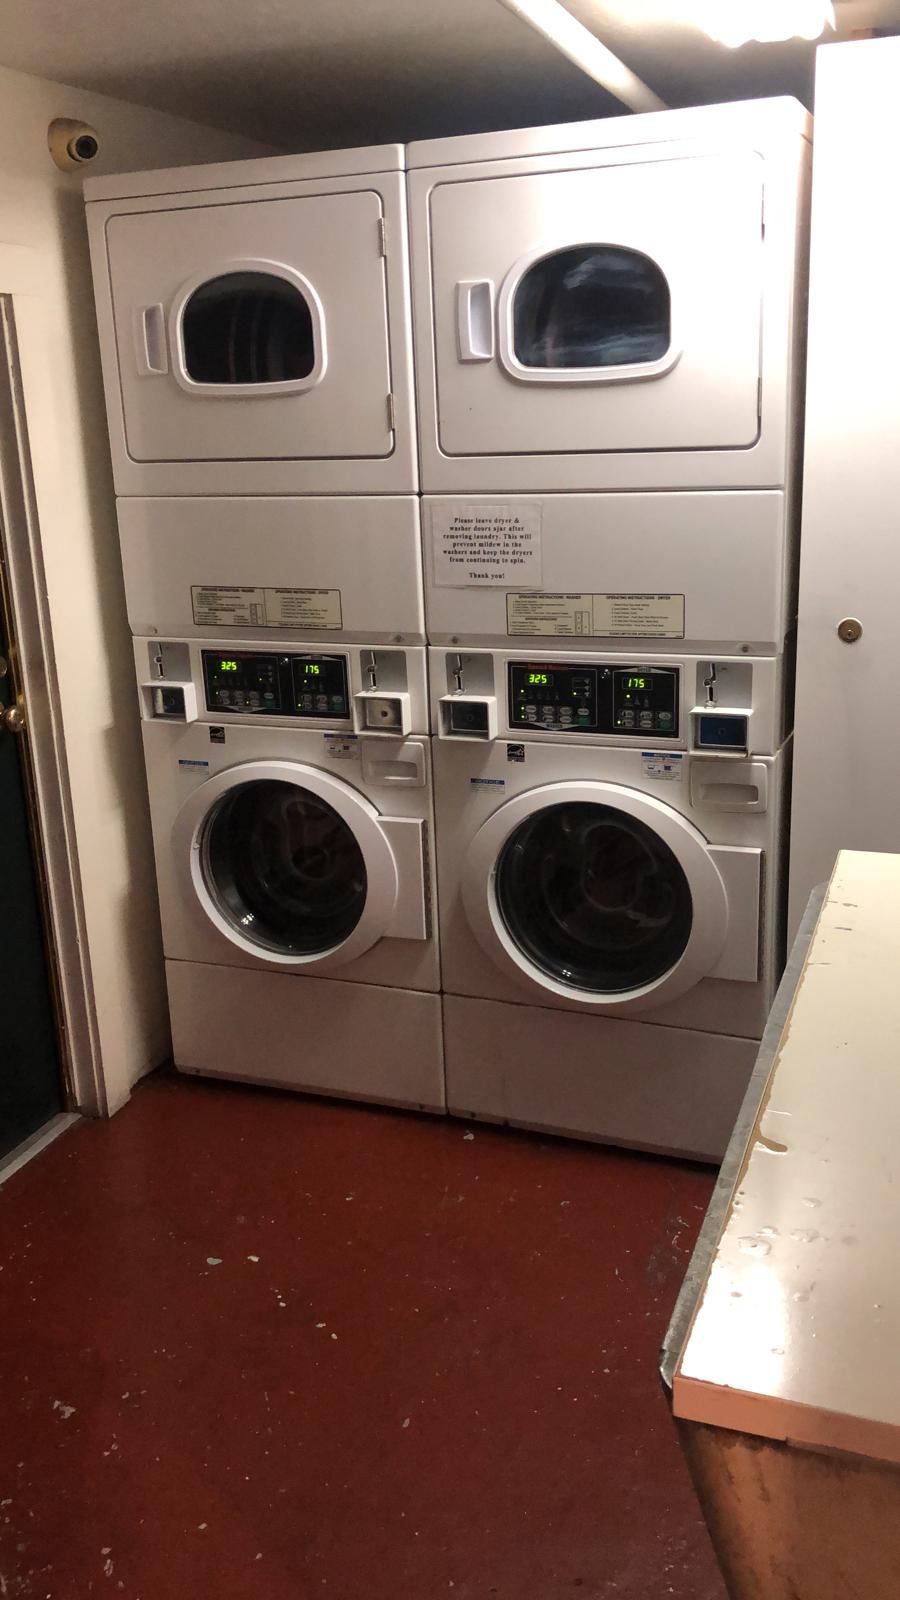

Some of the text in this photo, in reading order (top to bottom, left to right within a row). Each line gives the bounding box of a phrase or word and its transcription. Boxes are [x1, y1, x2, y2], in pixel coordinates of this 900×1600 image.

[494, 517, 512, 525] dryer
[221, 661, 237, 671] 325
[305, 665, 320, 674] 175
[528, 674, 547, 684] 325
[628, 678, 645, 688] 175
